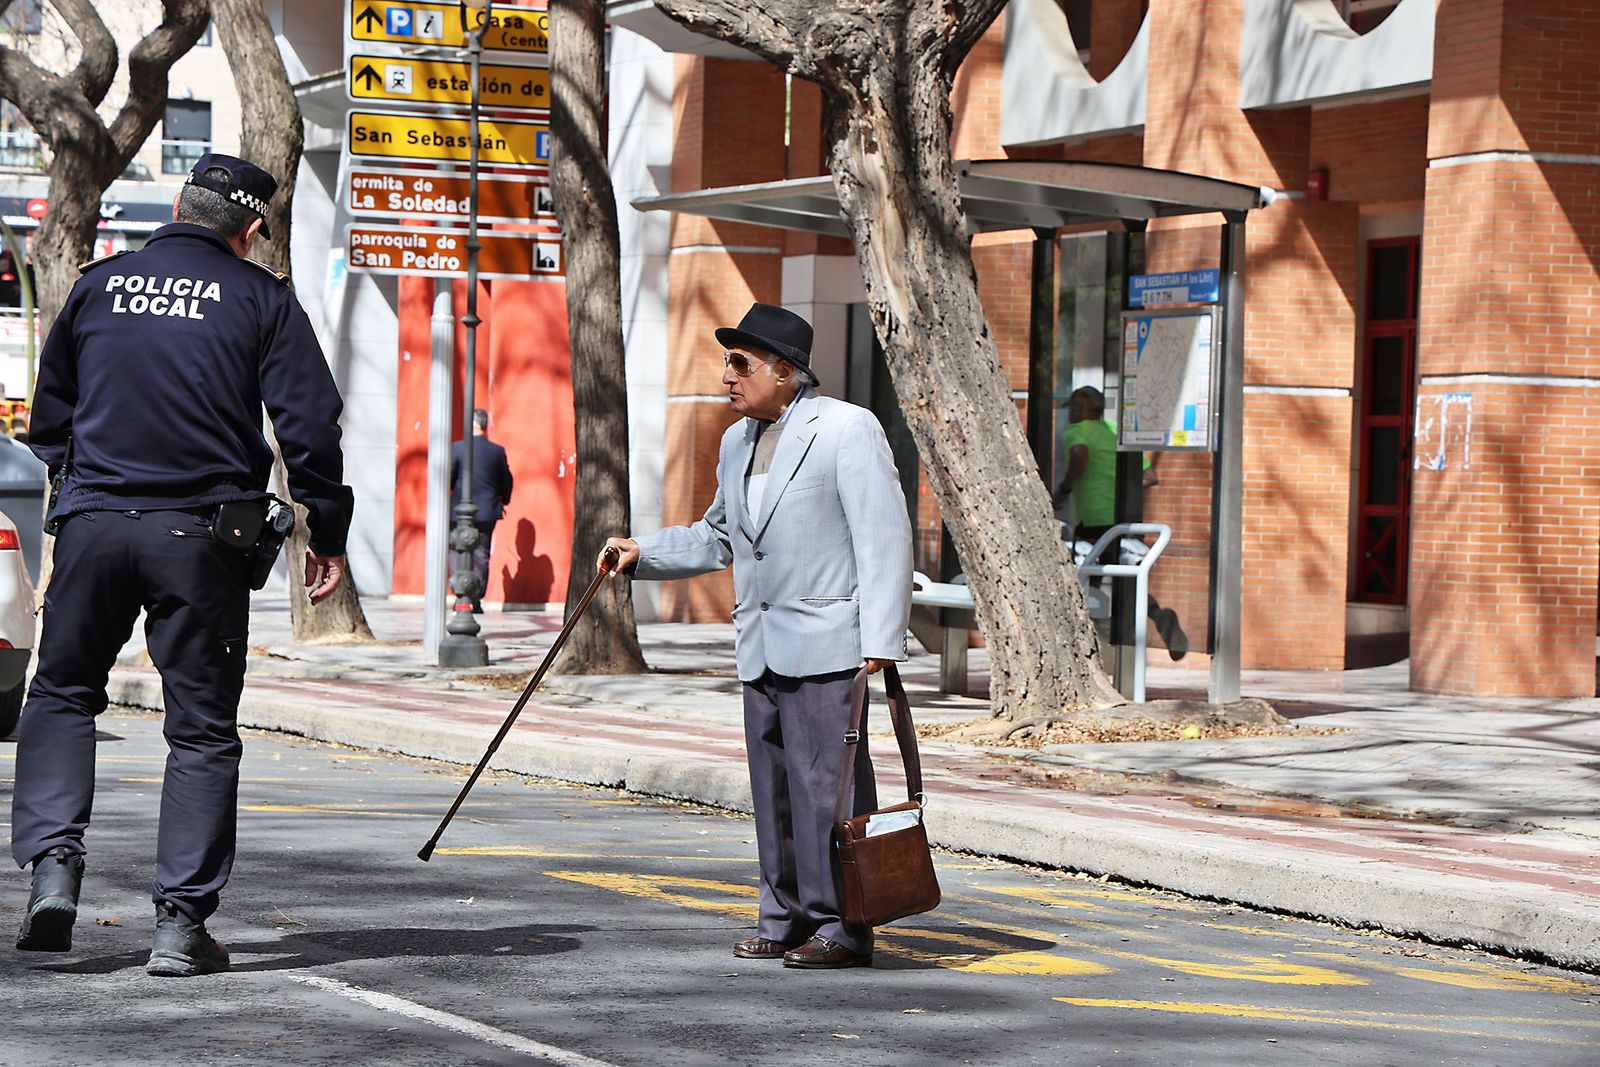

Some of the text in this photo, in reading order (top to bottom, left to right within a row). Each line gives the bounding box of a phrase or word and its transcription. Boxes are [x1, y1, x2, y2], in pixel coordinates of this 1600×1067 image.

[476, 11, 524, 29] Casa
[427, 76, 544, 96] estaión de
[355, 127, 393, 144] San
[407, 130, 507, 151] Sebasián
[352, 176, 433, 193] ermita de
[352, 191, 471, 214] La Soledad
[351, 233, 457, 250] parroquia de
[351, 249, 461, 271] San Pedro
[105, 274, 221, 302] POLICIA
[112, 293, 205, 320] LOCAL
